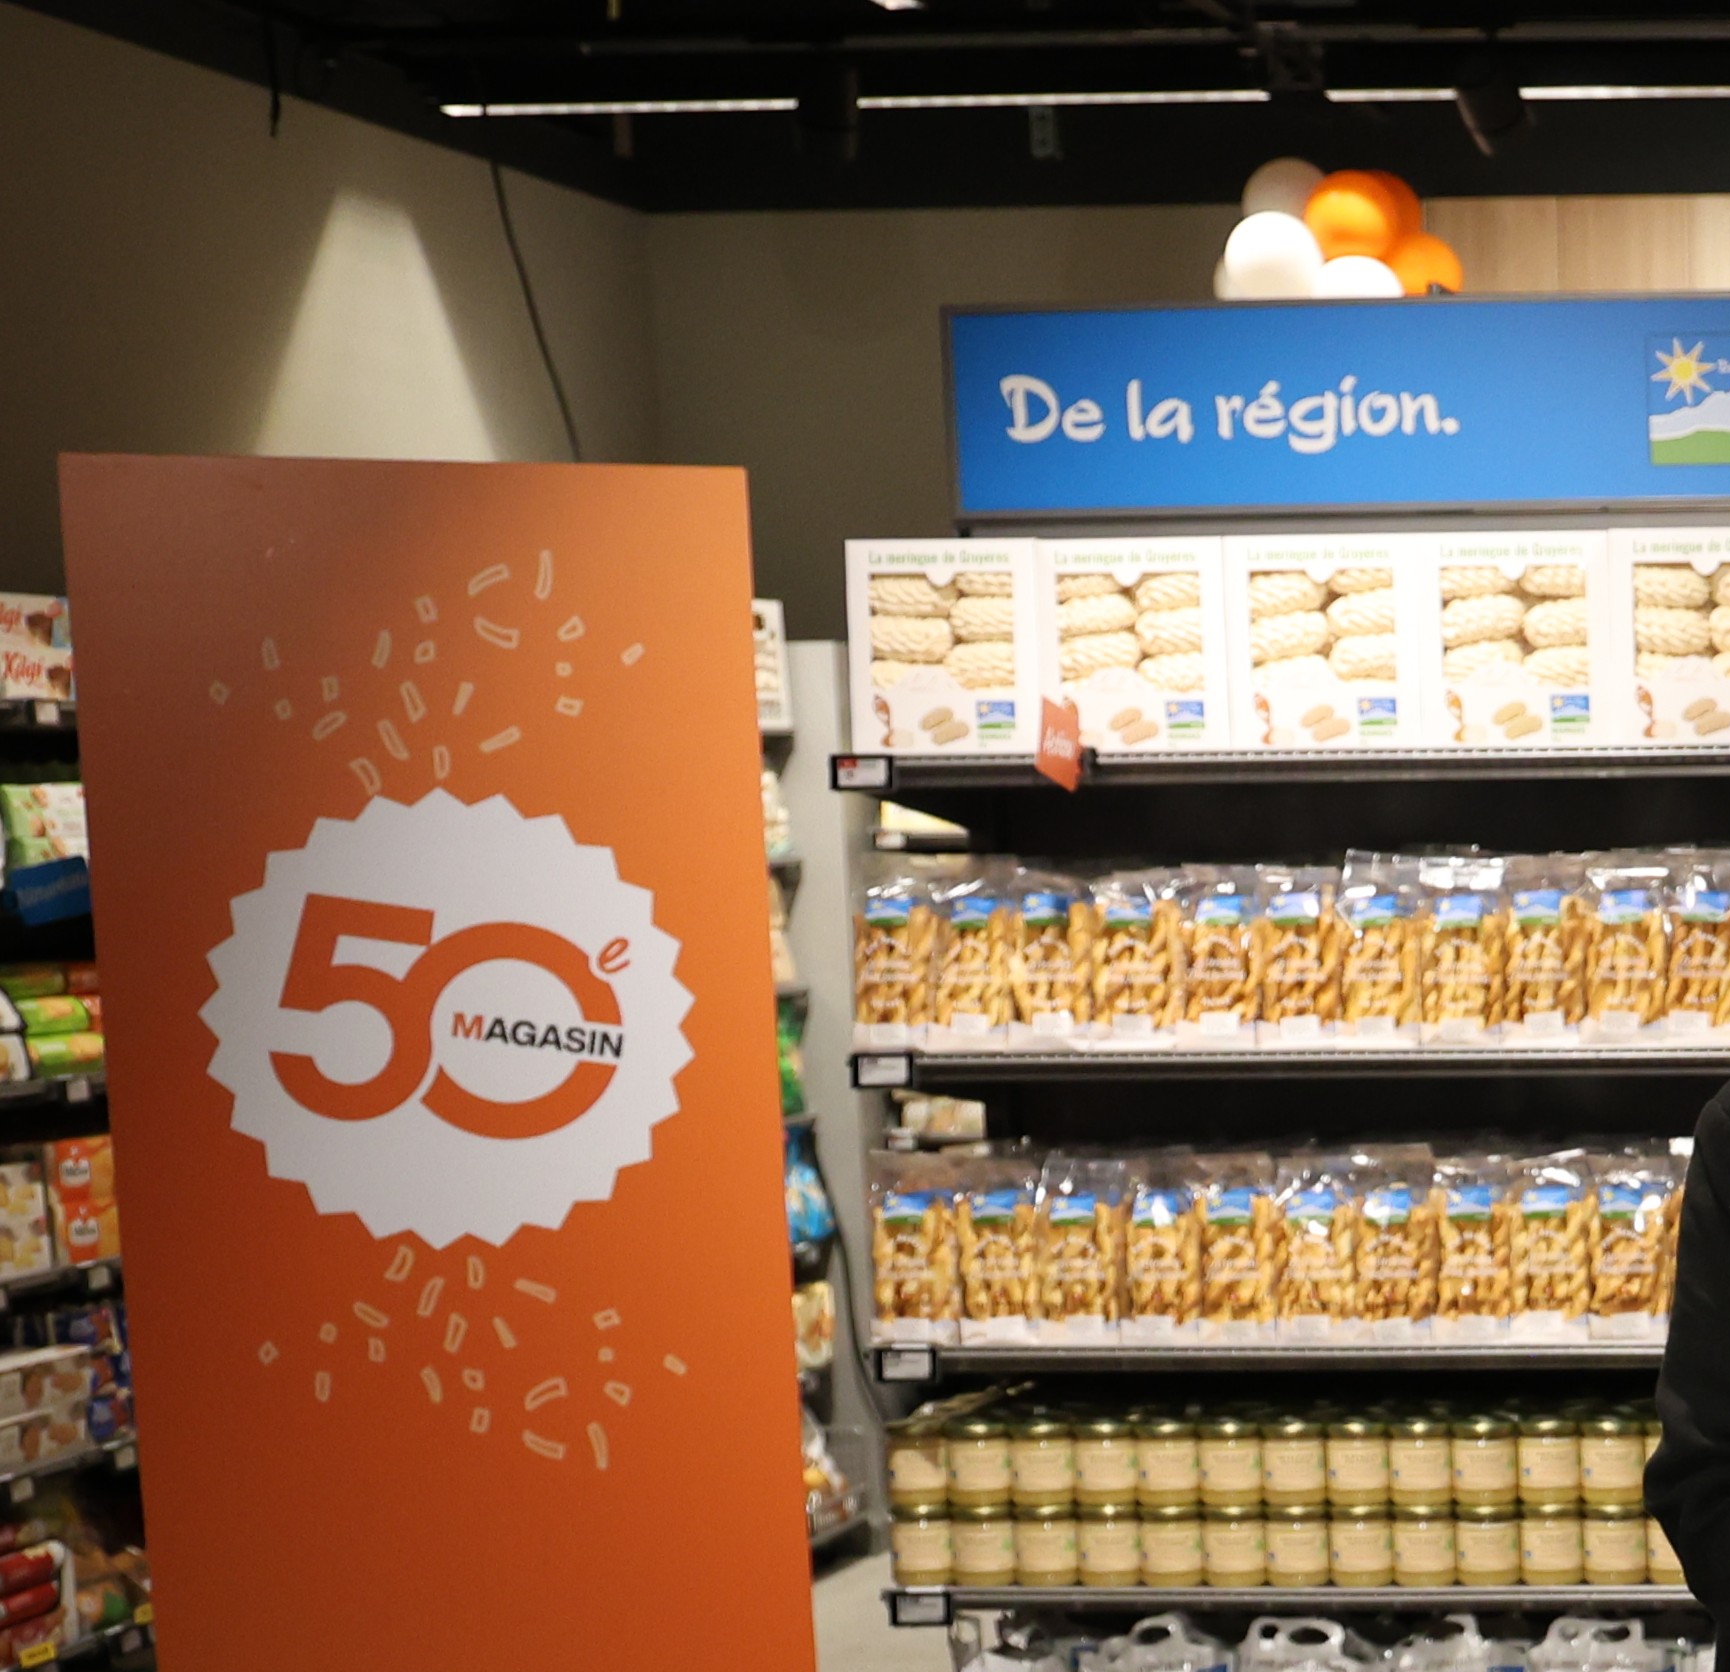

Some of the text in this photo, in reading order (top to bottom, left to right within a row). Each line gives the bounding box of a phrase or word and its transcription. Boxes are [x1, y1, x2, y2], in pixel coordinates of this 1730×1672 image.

[1000, 374, 1461, 454] De la région.
[452, 1012, 624, 1058] MAGASIN
